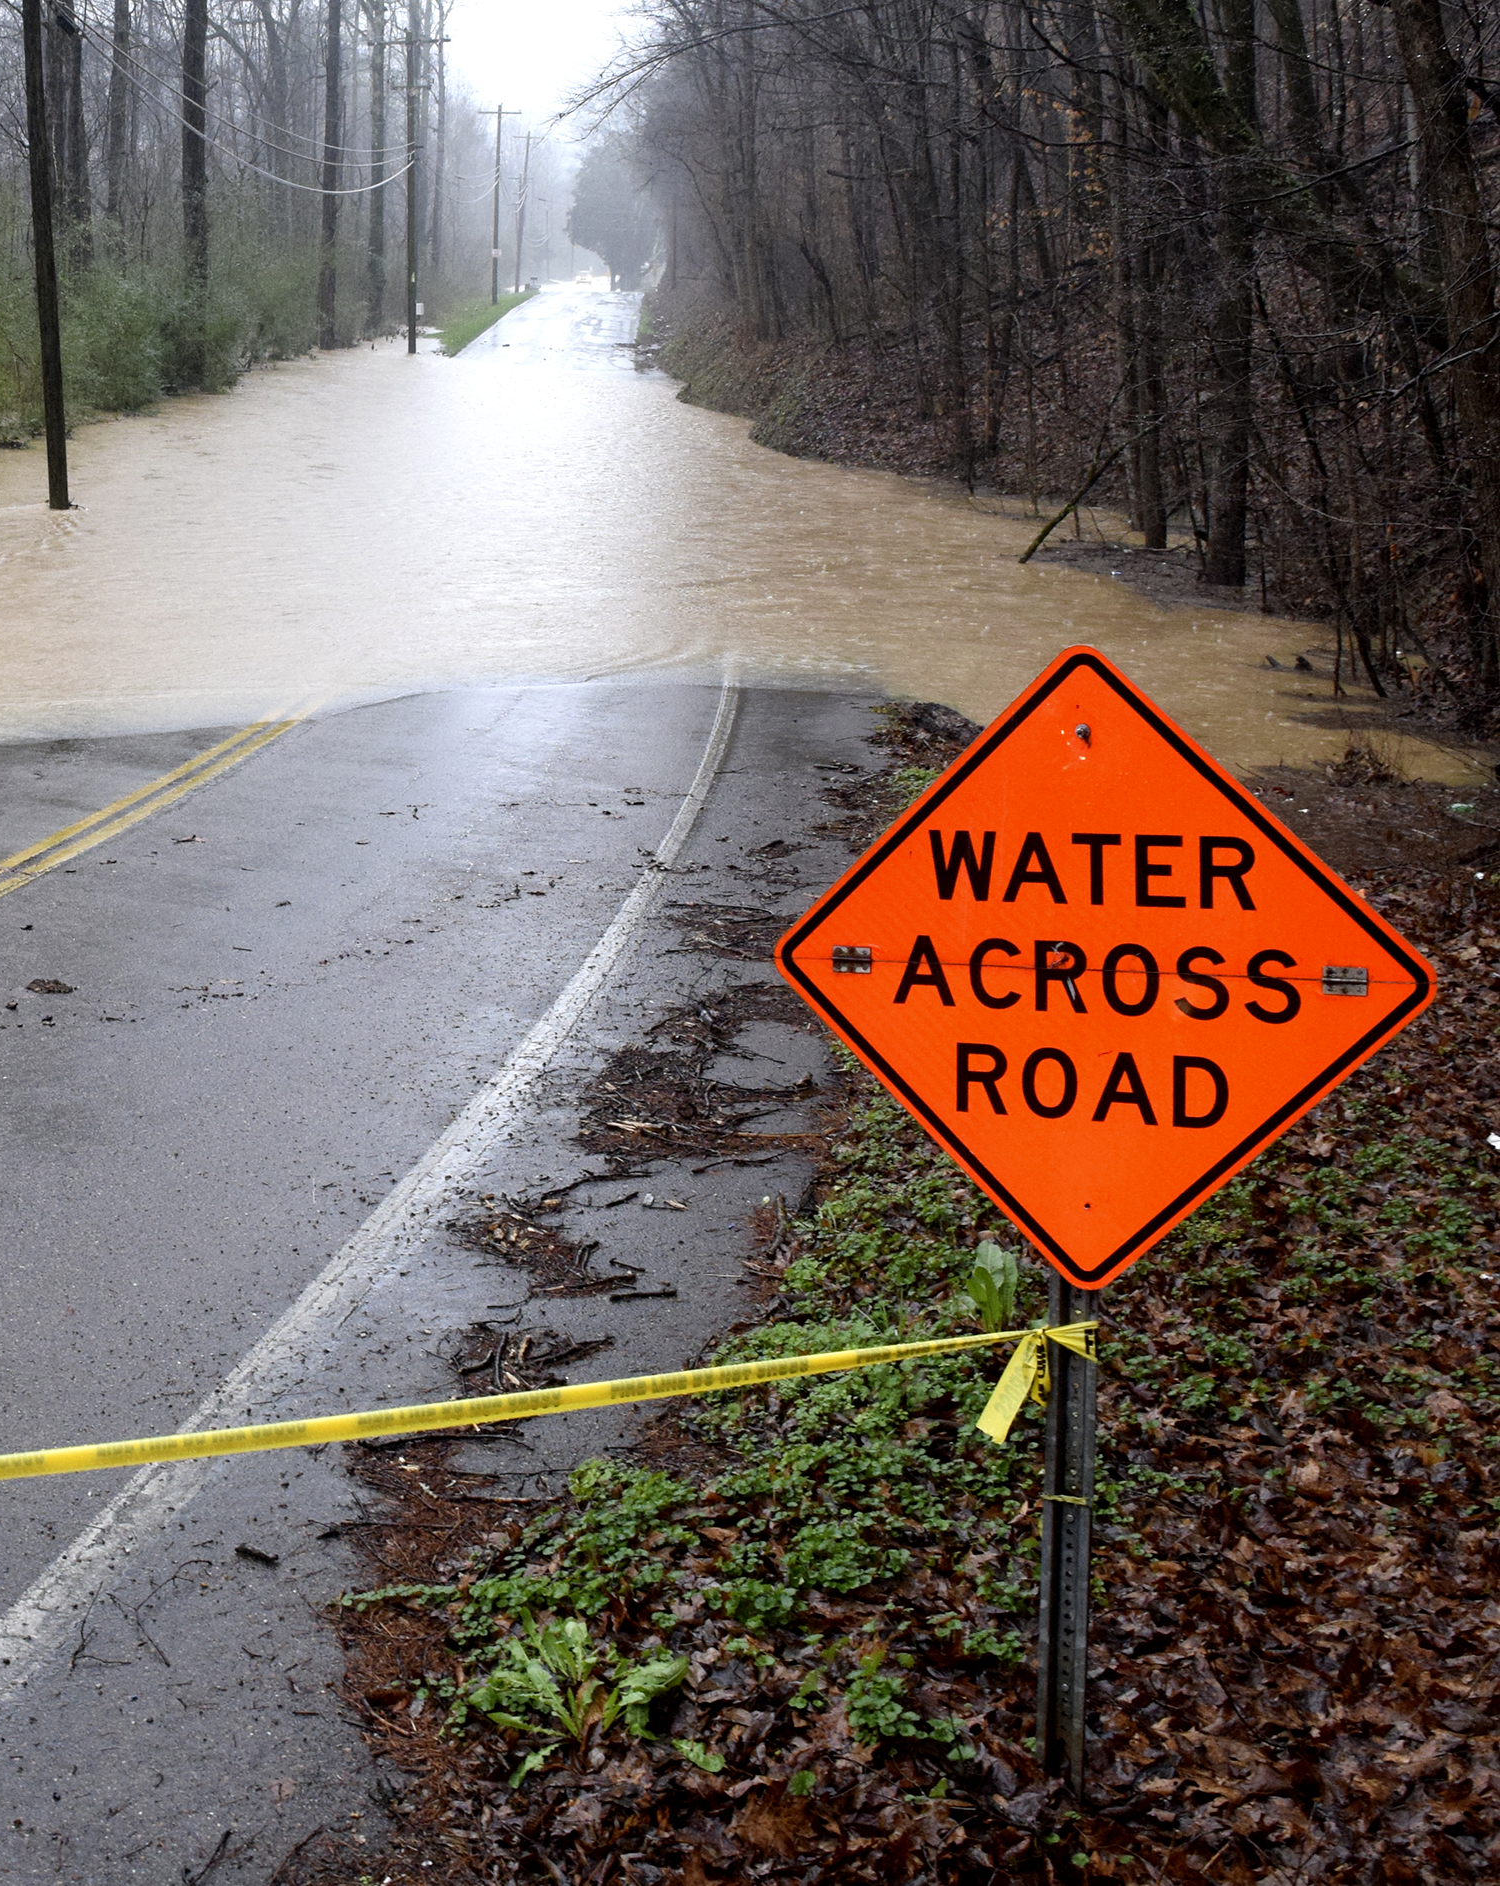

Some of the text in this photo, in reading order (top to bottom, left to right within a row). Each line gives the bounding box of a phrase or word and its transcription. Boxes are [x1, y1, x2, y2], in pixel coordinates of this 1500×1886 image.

[928, 829, 1256, 911] WATER
[893, 934, 1301, 1025] ACROSS
[956, 1042, 1229, 1129] ROAD
